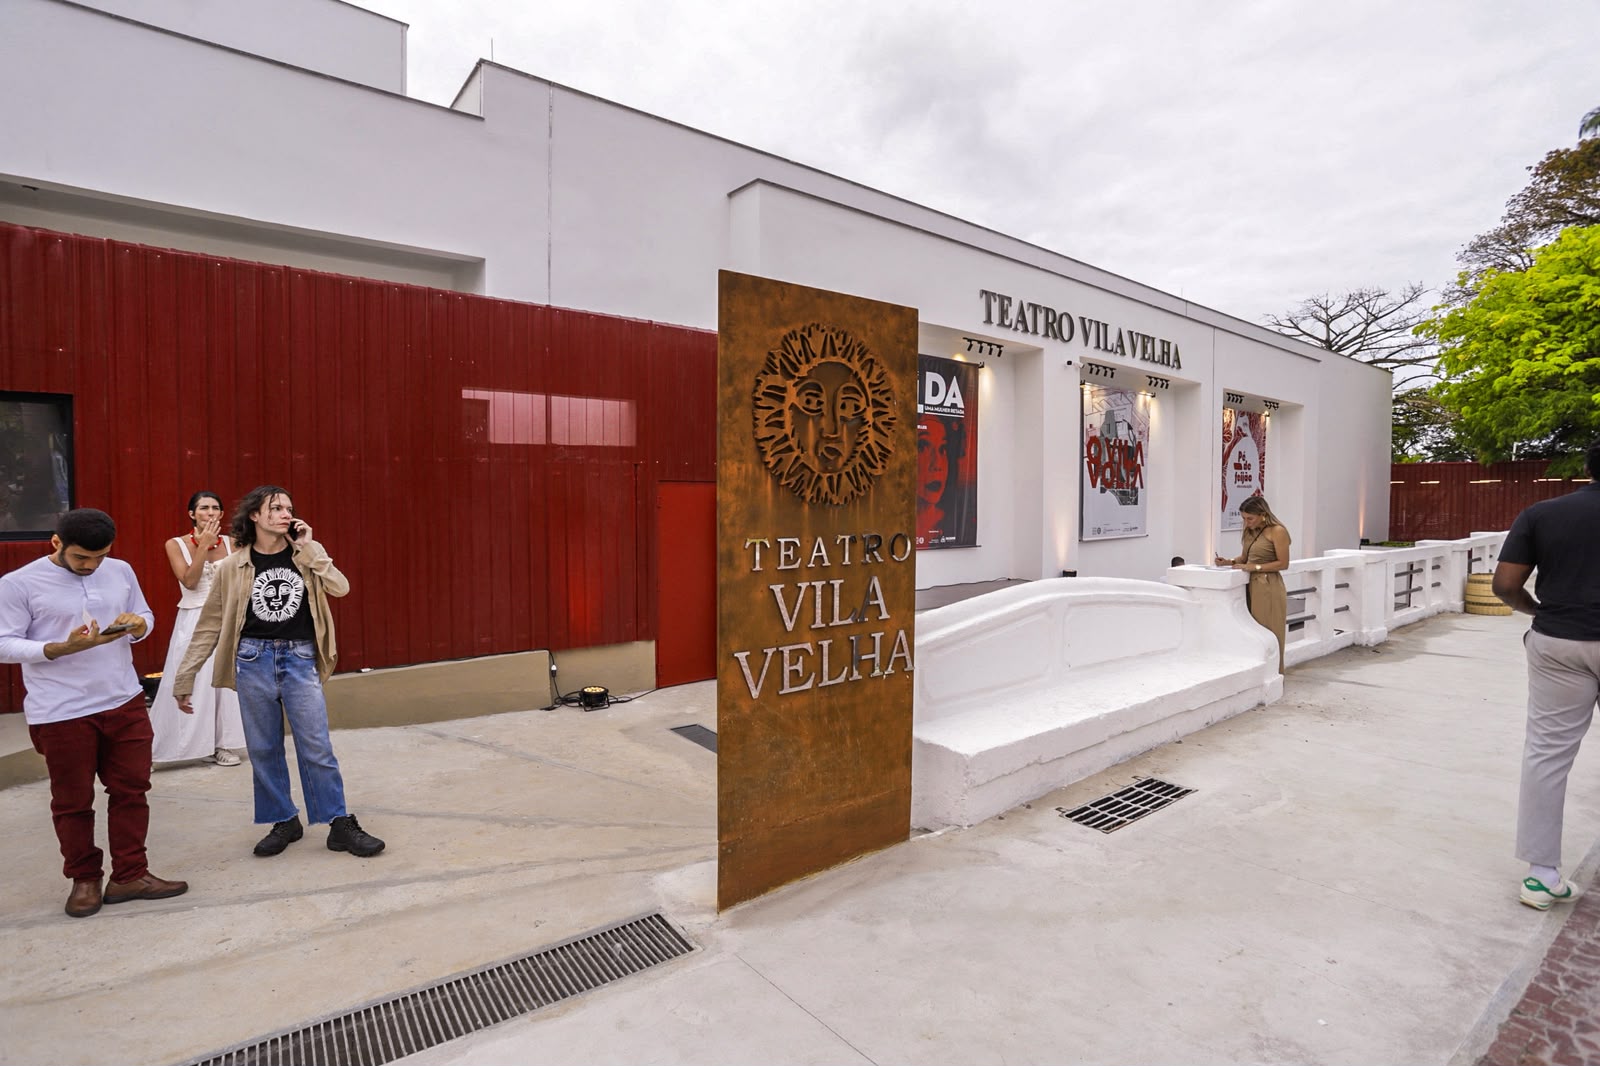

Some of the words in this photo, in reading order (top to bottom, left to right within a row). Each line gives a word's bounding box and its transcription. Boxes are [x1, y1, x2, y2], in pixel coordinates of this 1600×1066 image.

[980, 289, 1075, 343] TEATRO
[1078, 316, 1126, 356] VILA
[1127, 330, 1182, 369] VELHA
[917, 371, 965, 408] DA
[1104, 437, 1144, 467] VILA
[1238, 451, 1246, 462] Pé
[1087, 461, 1144, 489] VOLTA
[1234, 471, 1252, 485] feijão
[744, 533, 911, 572] TEATRO
[769, 576, 890, 632] VILA
[733, 629, 914, 700] VELHA
